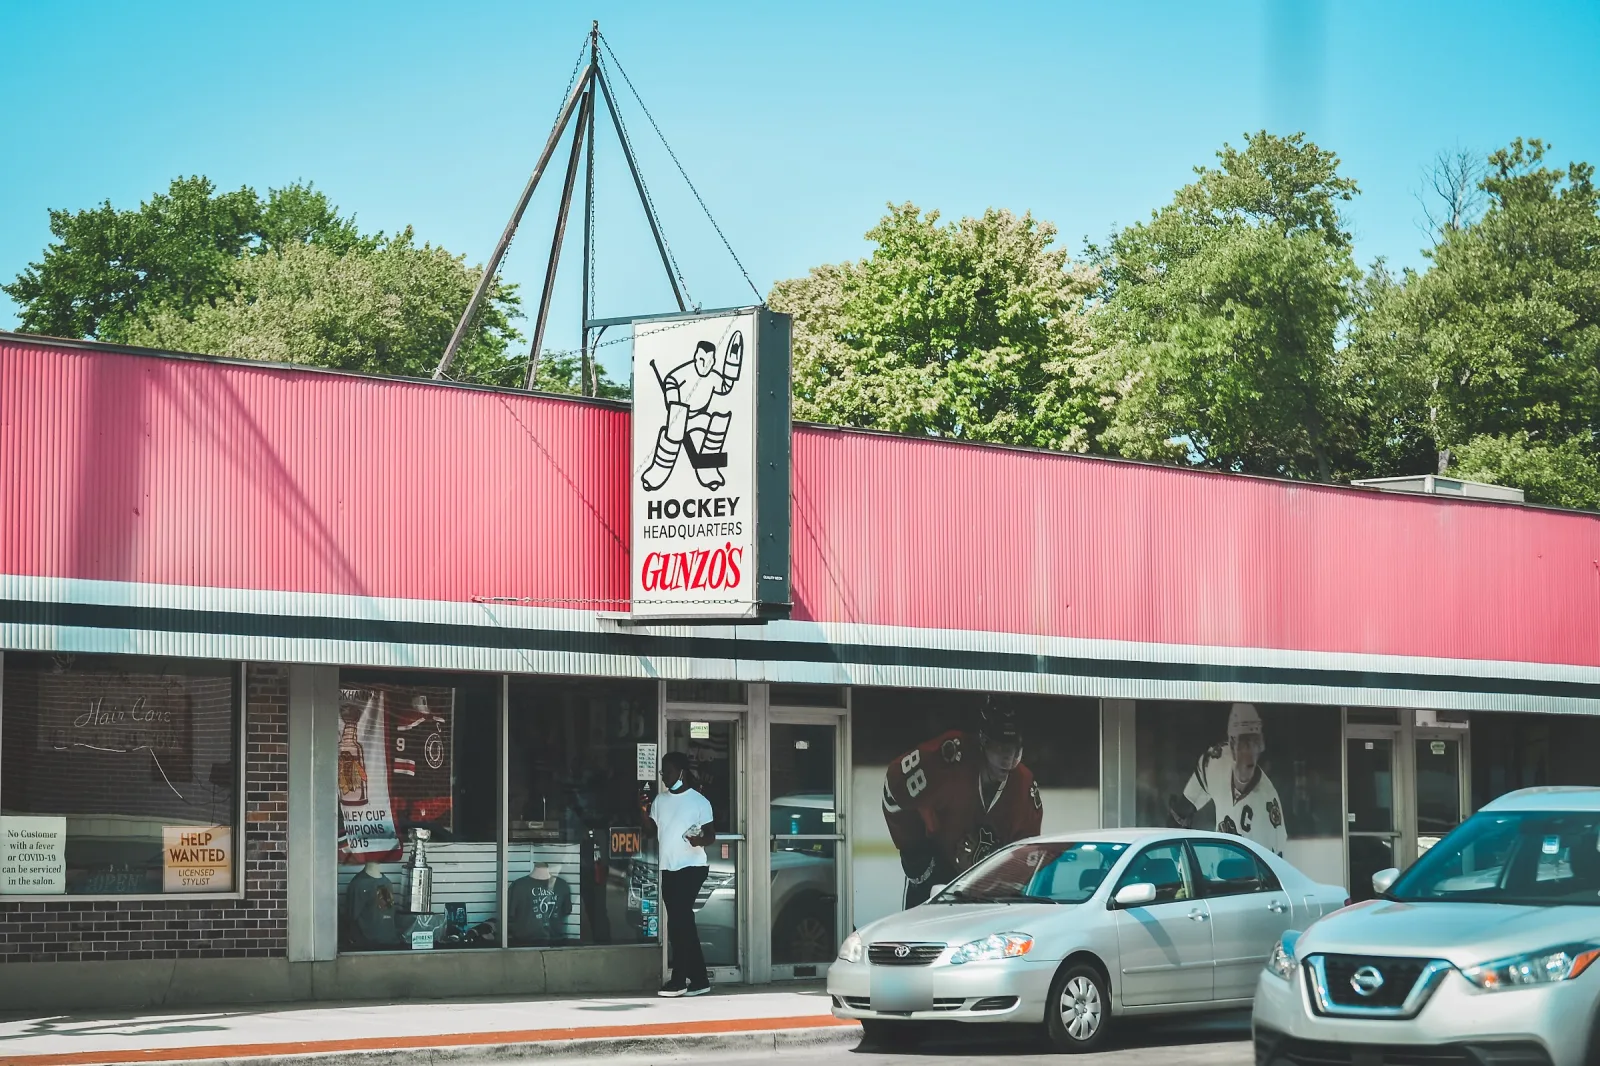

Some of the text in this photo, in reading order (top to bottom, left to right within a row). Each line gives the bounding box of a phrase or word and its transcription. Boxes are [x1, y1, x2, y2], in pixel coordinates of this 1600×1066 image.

[647, 497, 741, 520] HOCKEY
[643, 522, 743, 540] HEADQUARTERS
[641, 541, 744, 592] GUNZO'S
[73, 694, 172, 727] Hair Care
[900, 749, 928, 798] 88
[365, 810, 386, 822] CUP
[1240, 804, 1254, 833] C
[7, 829, 58, 839] No Customer
[180, 832, 213, 846] HELP
[9, 840, 28, 850] with
[35, 841, 55, 850] fever
[349, 838, 369, 849] 2015
[611, 832, 640, 853] OPEN
[7, 853, 57, 862] or COVID-19
[169, 848, 226, 863] WANTED
[2, 864, 62, 874] can be serviced
[178, 868, 215, 877] LICENSED
[8, 876, 56, 886] in the salon.
[182, 877, 211, 886] STYLIST
